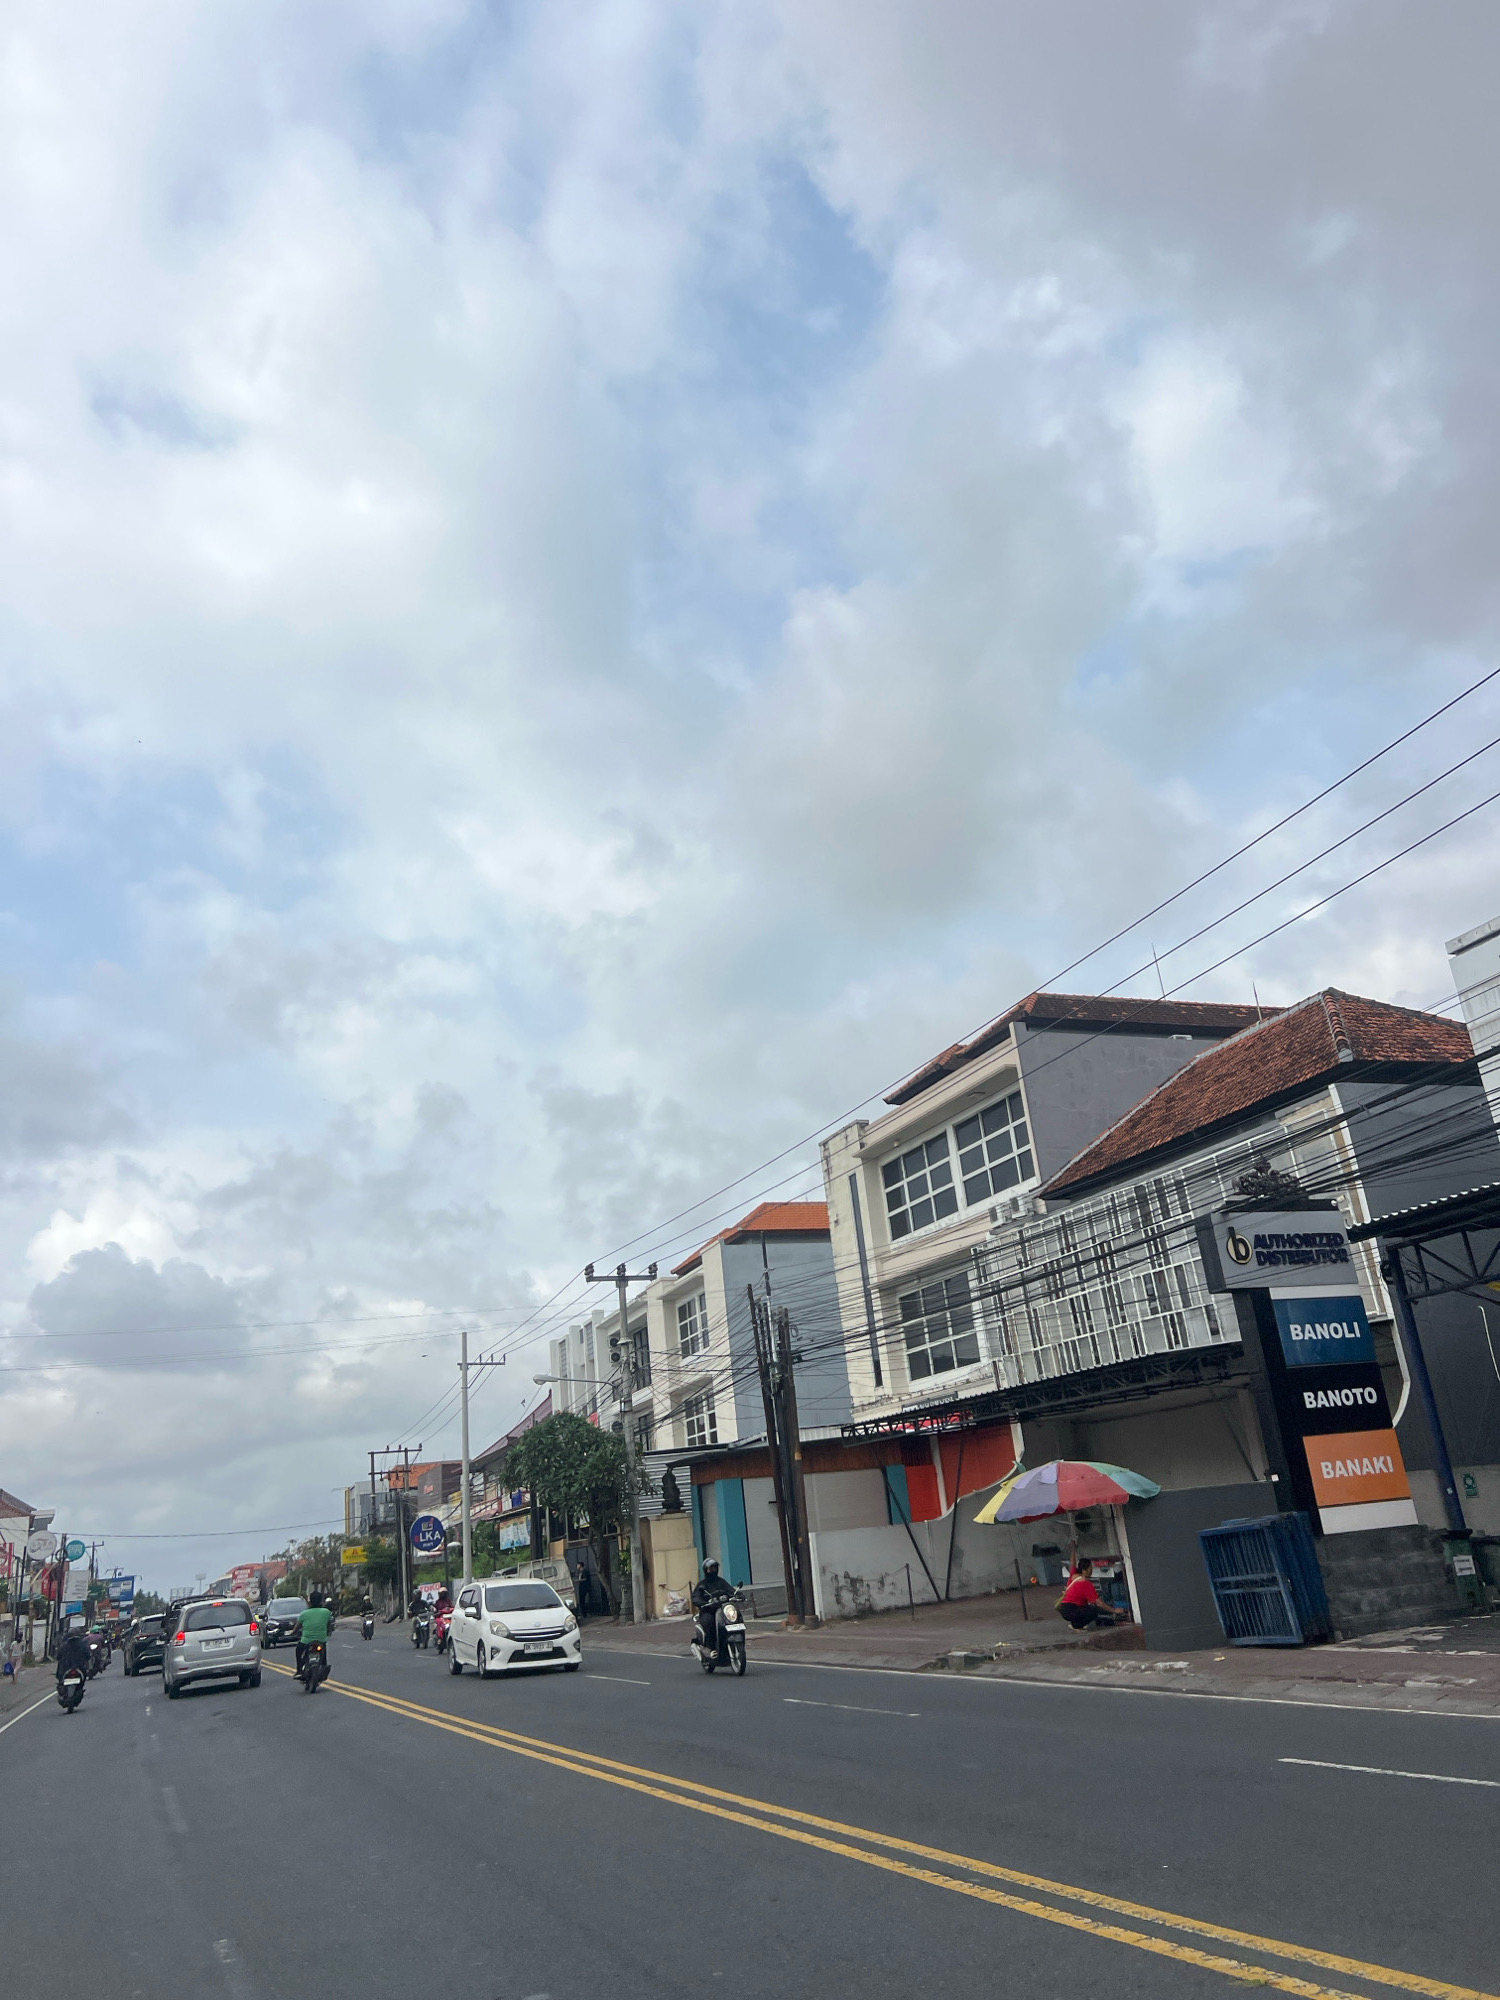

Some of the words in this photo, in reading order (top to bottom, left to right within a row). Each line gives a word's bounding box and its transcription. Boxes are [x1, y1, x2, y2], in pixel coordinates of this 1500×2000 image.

[1254, 1233, 1345, 1249] AUTHORIZED
[1256, 1248, 1349, 1266] DISTRIBUTOR
[1290, 1321, 1361, 1341] BANOLI
[1303, 1387, 1378, 1409] BANOTO
[1320, 1455, 1394, 1479] BANAKI
